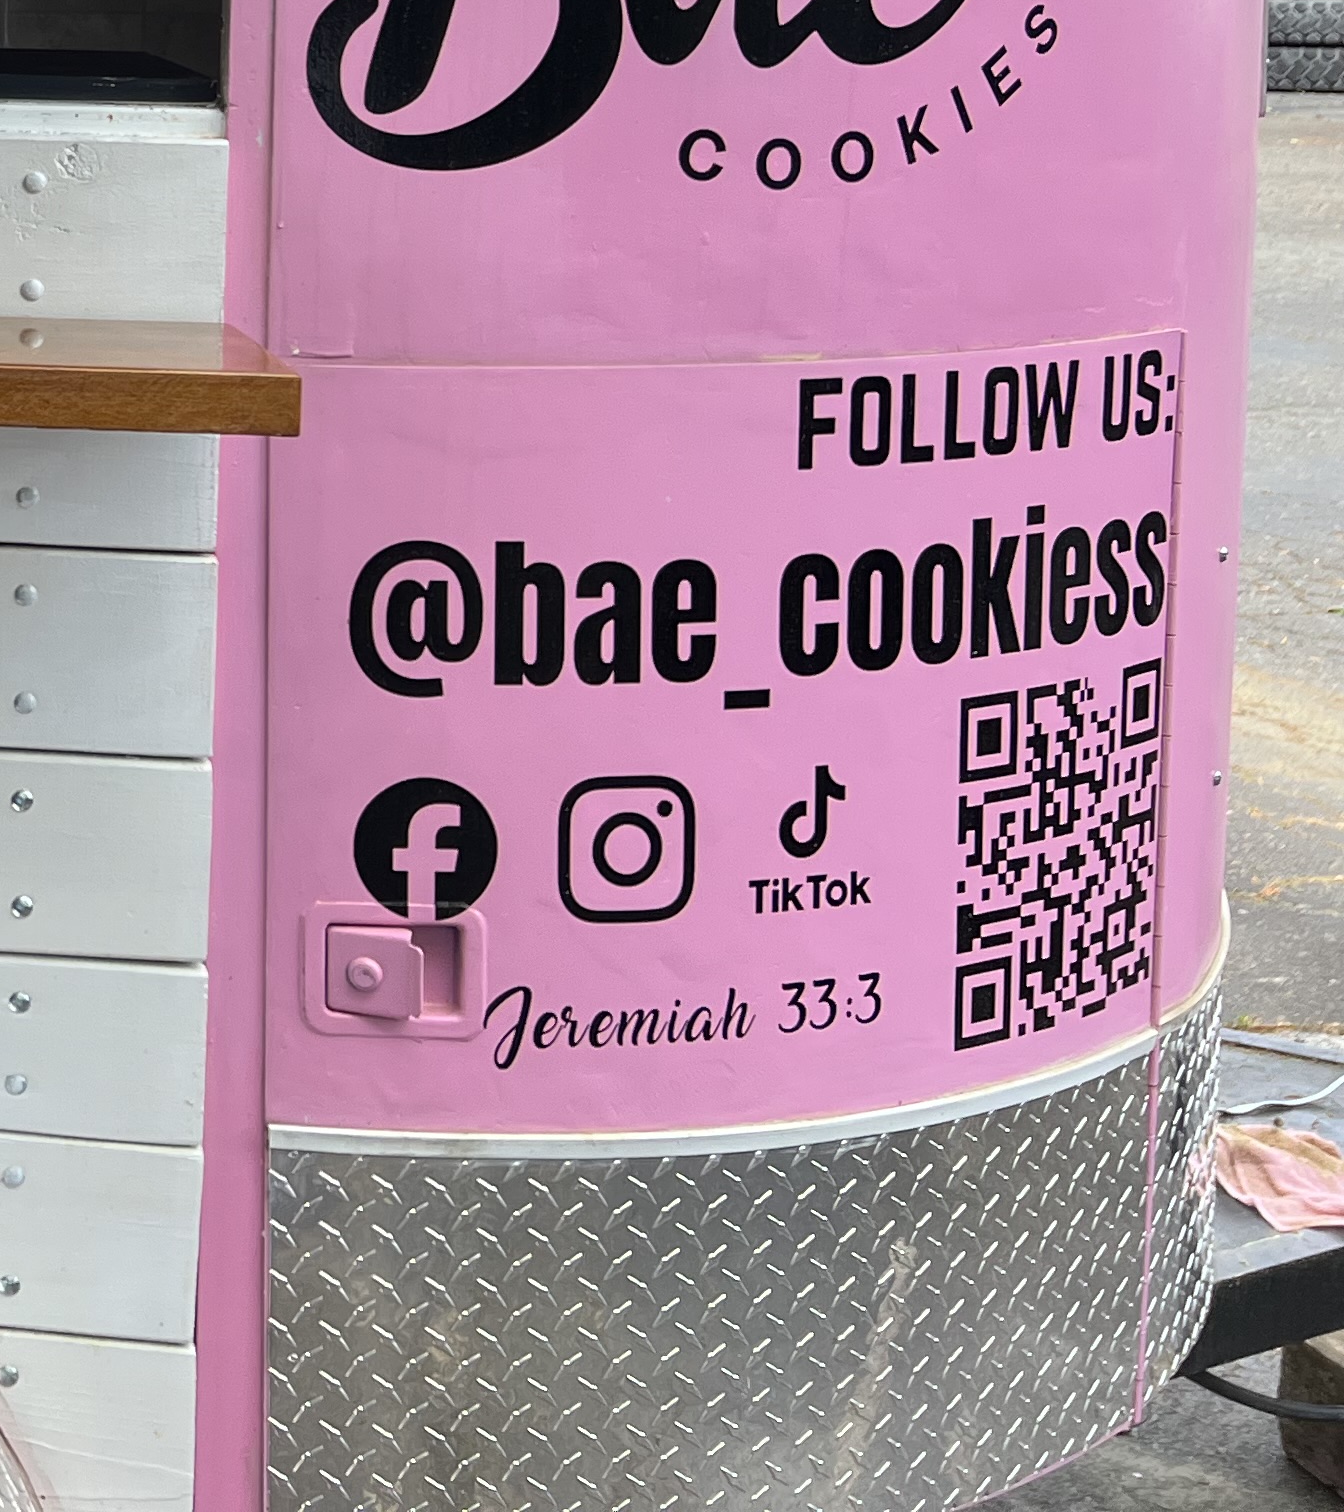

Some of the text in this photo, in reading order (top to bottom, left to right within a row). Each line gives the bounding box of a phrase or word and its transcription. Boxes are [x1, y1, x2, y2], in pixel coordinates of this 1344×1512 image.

[678, 3, 1060, 191] COOKIES
[797, 348, 1176, 471] FOLLOW US:
[348, 503, 1168, 711] @bae_cookiess
[748, 870, 872, 915] TikTok
[482, 972, 883, 1071] Jeremiah 33:3
